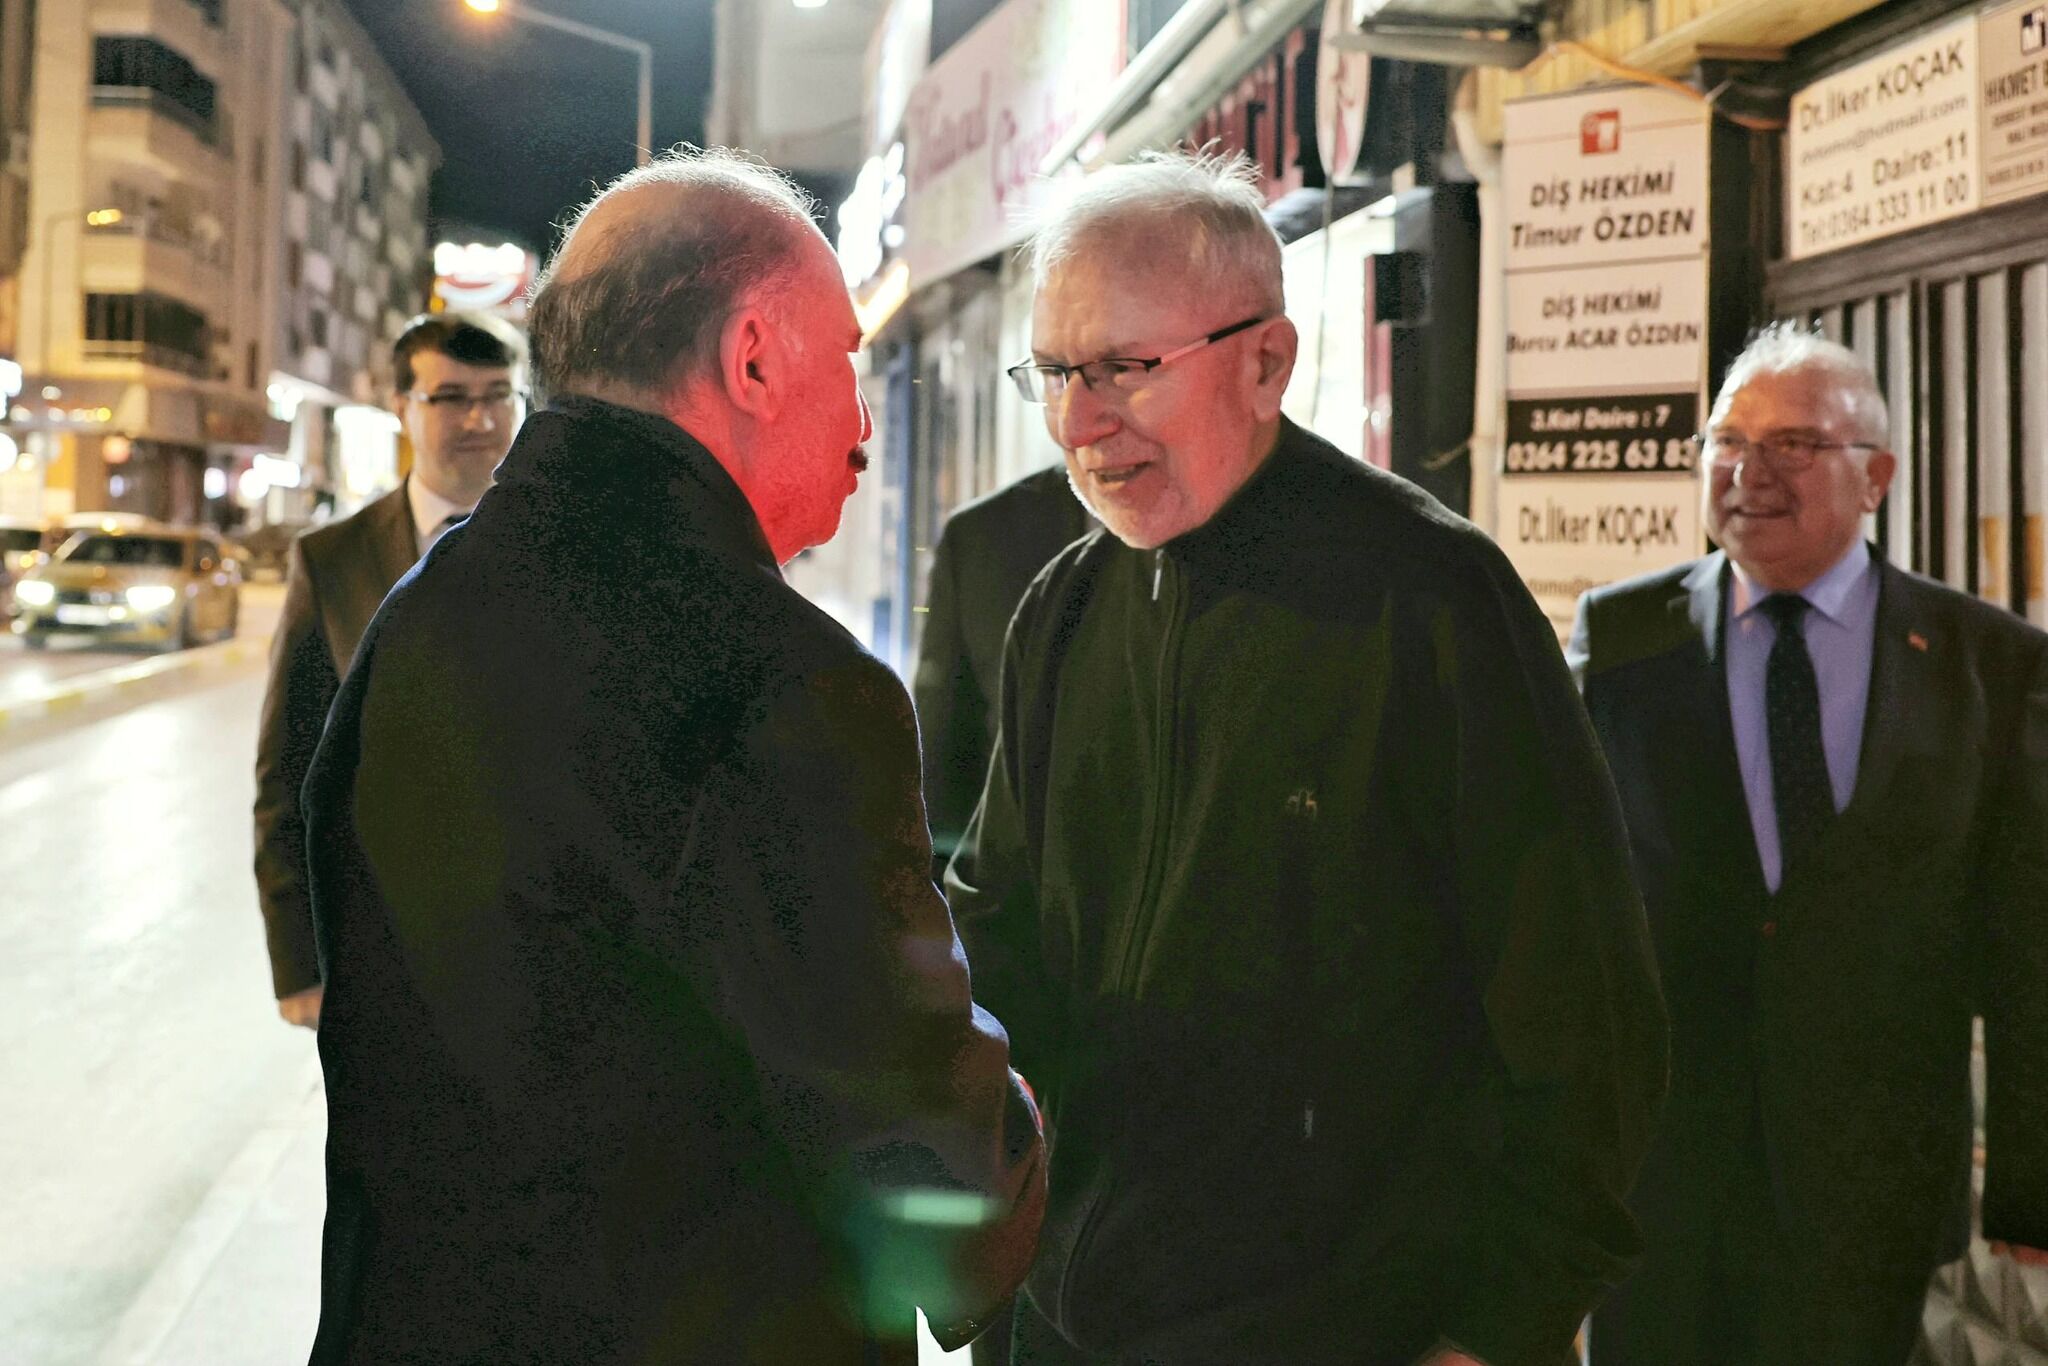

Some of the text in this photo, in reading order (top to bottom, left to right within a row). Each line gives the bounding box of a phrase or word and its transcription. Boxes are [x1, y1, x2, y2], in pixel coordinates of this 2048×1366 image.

[1876, 40, 1963, 100] KOÇAK
[1530, 161, 1676, 211] DİŞ HEKİMİ
[1876, 190, 1909, 225] 333
[1918, 183, 1937, 213] 11
[1944, 172, 1969, 206] 00
[1511, 206, 1695, 249] Timur ÖZDEN
[1542, 284, 1662, 321] DİŞ HEKİMİ
[1505, 319, 1700, 354] Burcu ACAR ÖZDEN
[1655, 404, 1672, 428] 7
[1507, 440, 1567, 471] 0364
[1572, 439, 1620, 470] 225
[1624, 438, 1658, 469] 63
[1596, 505, 1679, 553] KOÇAK
